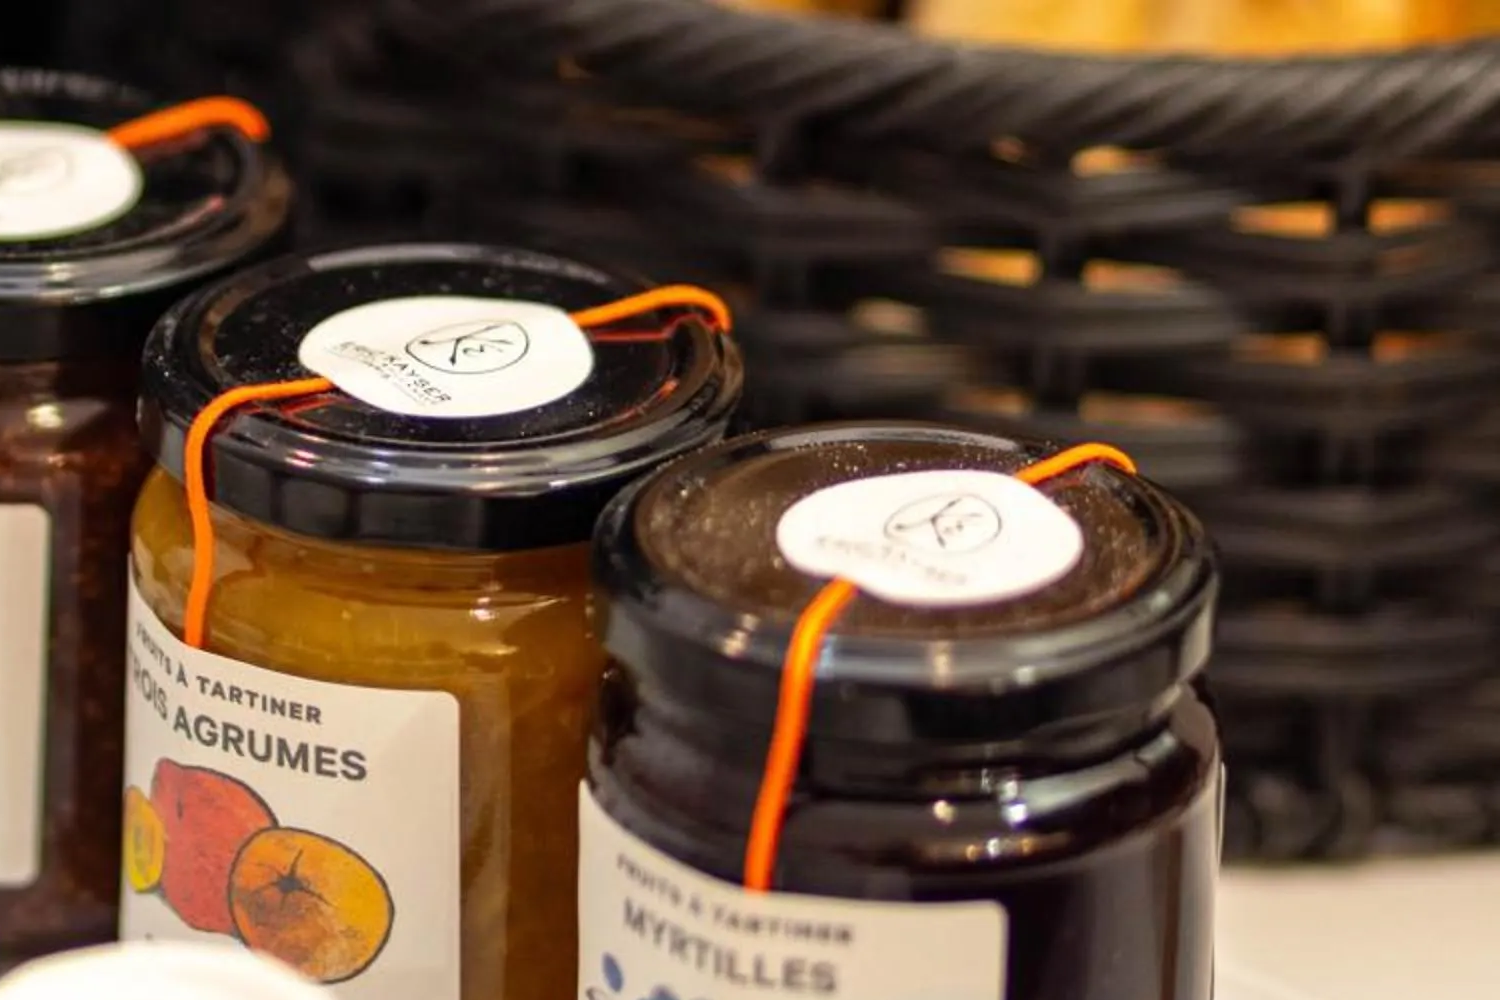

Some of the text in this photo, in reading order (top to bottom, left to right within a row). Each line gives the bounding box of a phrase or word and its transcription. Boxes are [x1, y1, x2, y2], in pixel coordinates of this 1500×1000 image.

[381, 352, 452, 402] KAYSER
[135, 620, 172, 676] FRUITS
[195, 674, 323, 725] TARTINER
[172, 704, 369, 783] AGRUMES
[615, 852, 683, 909] FRUITS
[712, 904, 855, 945] TARTINER
[622, 896, 839, 995] MYRTILLES
